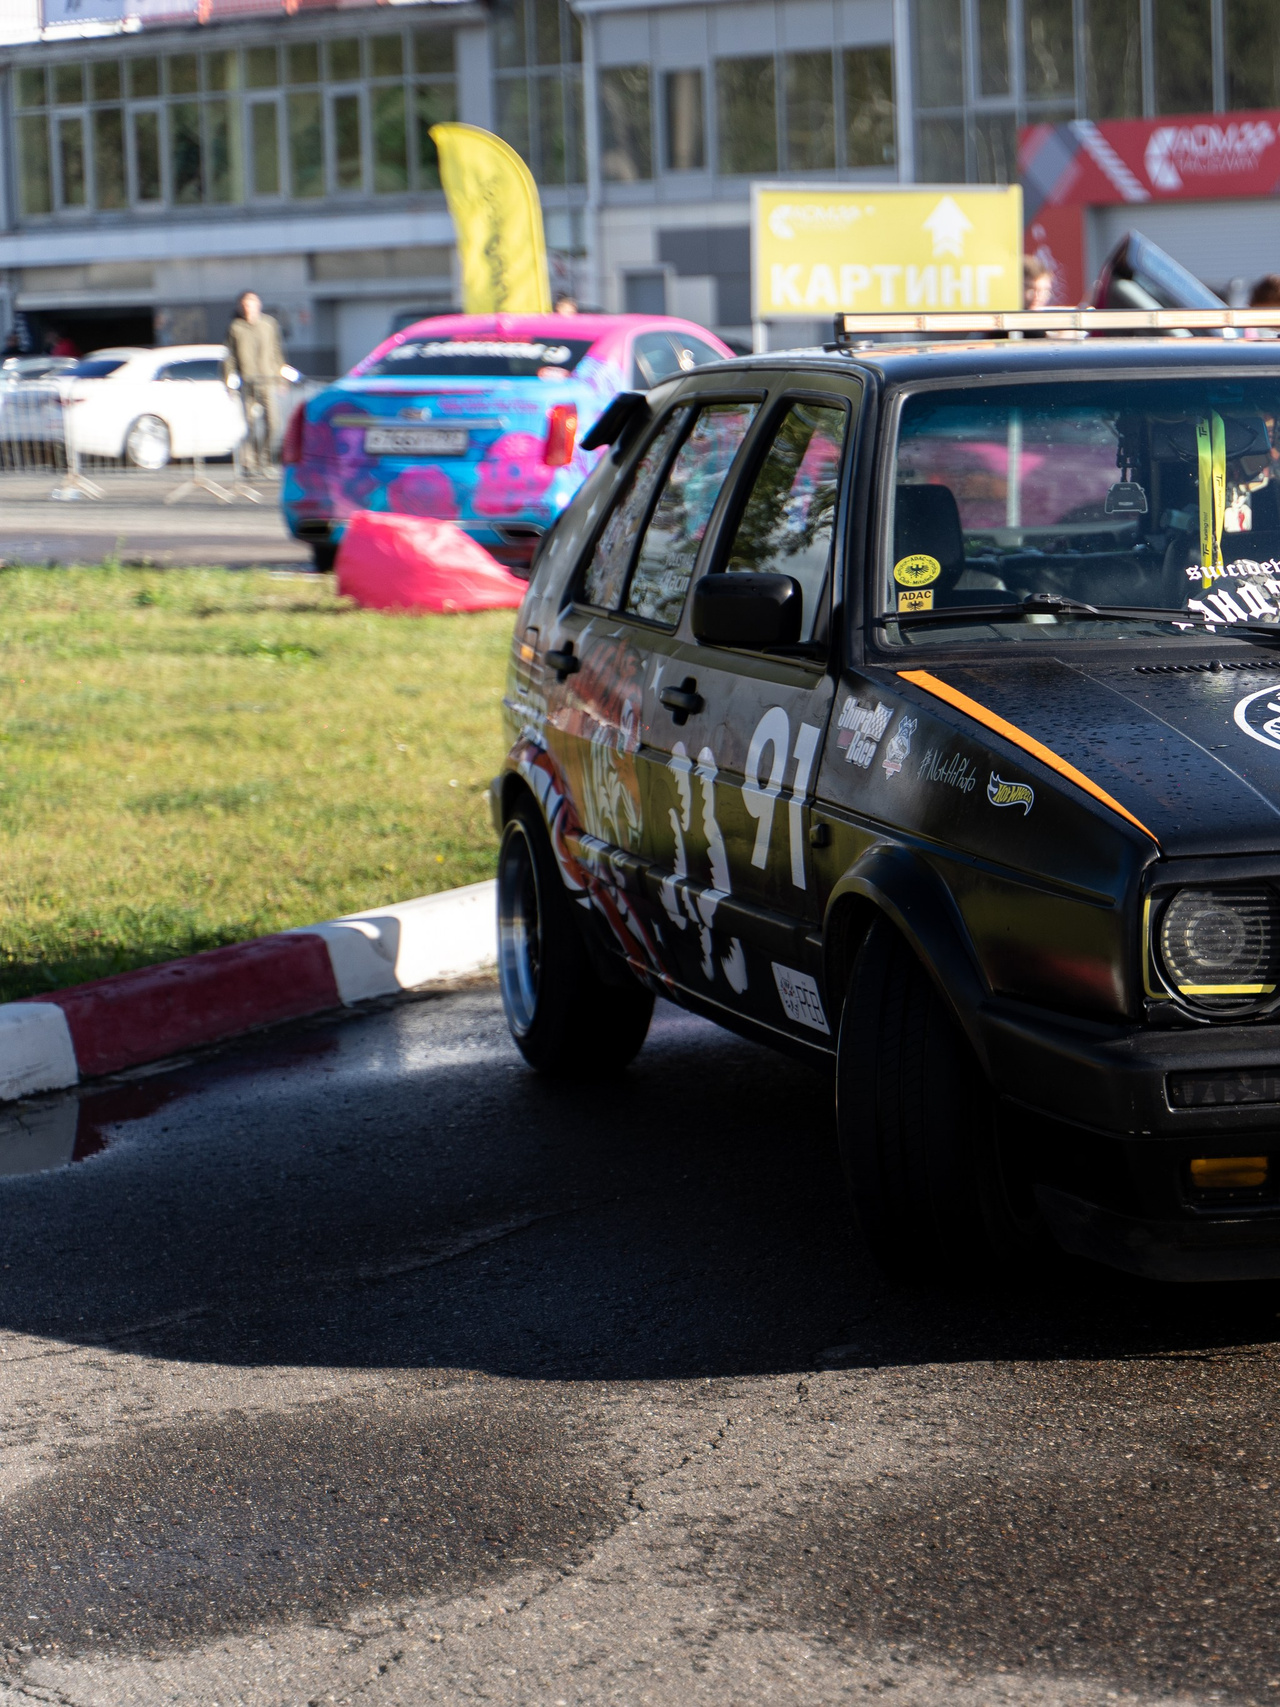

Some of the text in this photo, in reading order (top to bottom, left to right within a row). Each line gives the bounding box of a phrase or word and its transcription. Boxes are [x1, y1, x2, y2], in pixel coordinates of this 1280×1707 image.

[770, 263, 1005, 307] КАРТИНГ
[1202, 543, 1209, 557] TF
[900, 590, 932, 602] ADAC
[837, 694, 876, 734] Shura
[844, 730, 878, 769] Race
[742, 705, 821, 891] 91
